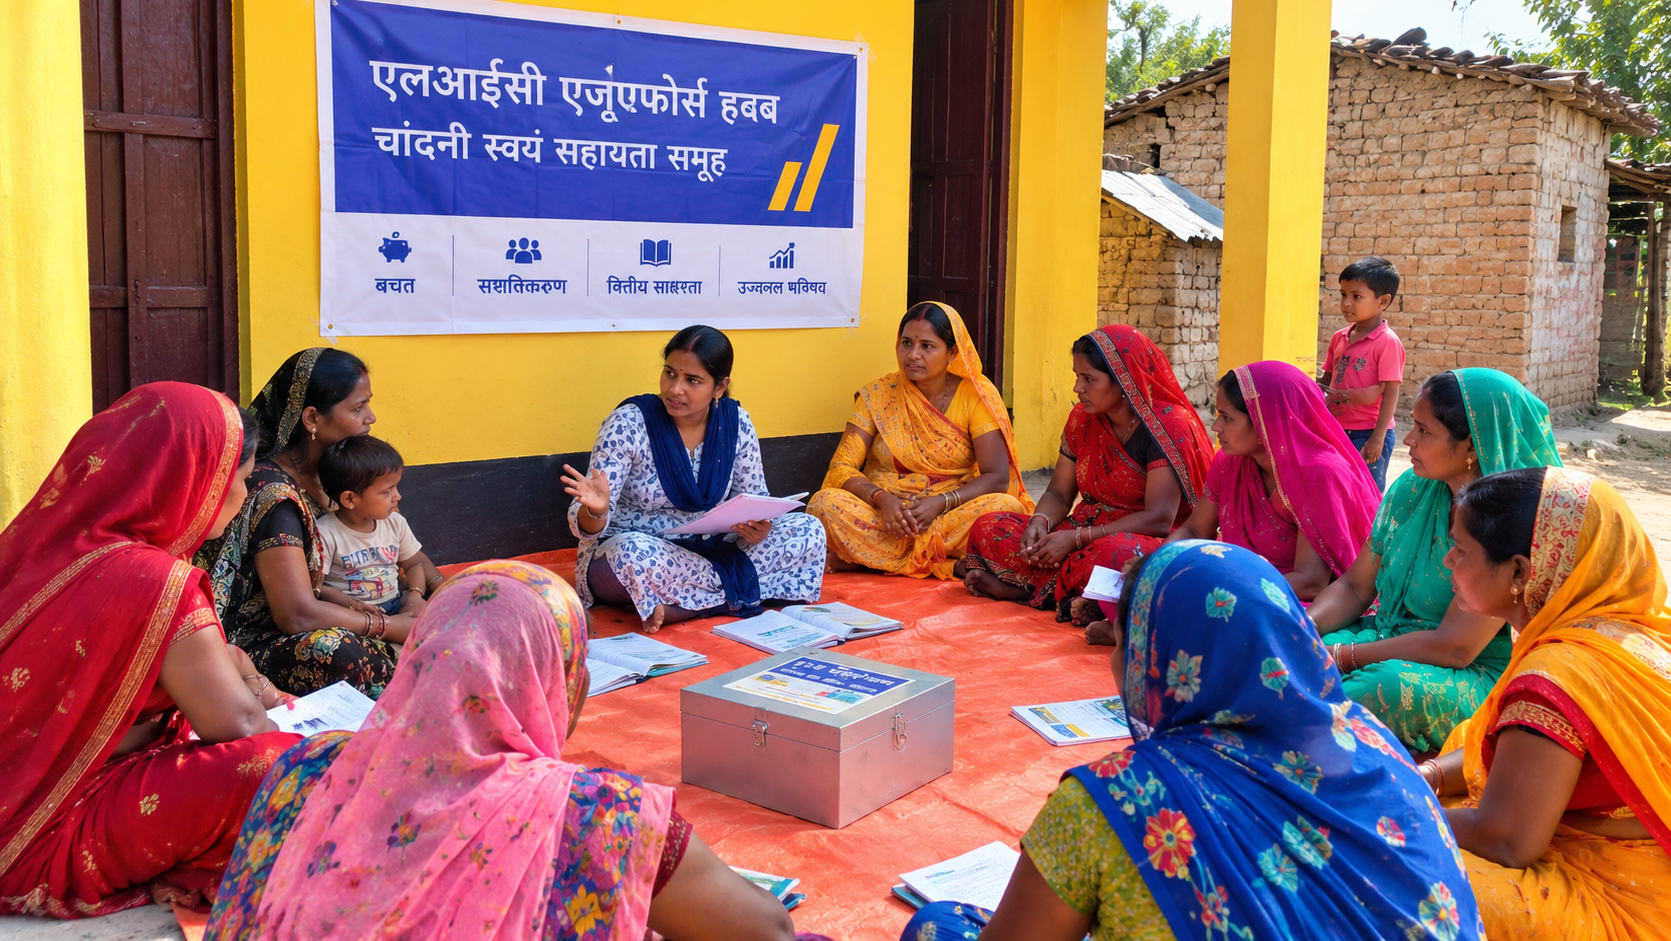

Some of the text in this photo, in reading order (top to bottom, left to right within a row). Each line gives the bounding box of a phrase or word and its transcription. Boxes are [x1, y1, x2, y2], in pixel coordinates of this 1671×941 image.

[369, 57, 548, 109] एलआईसी
[371, 120, 729, 182] चांदनी स्वयं सहायता समूह
[374, 278, 416, 294] बचत
